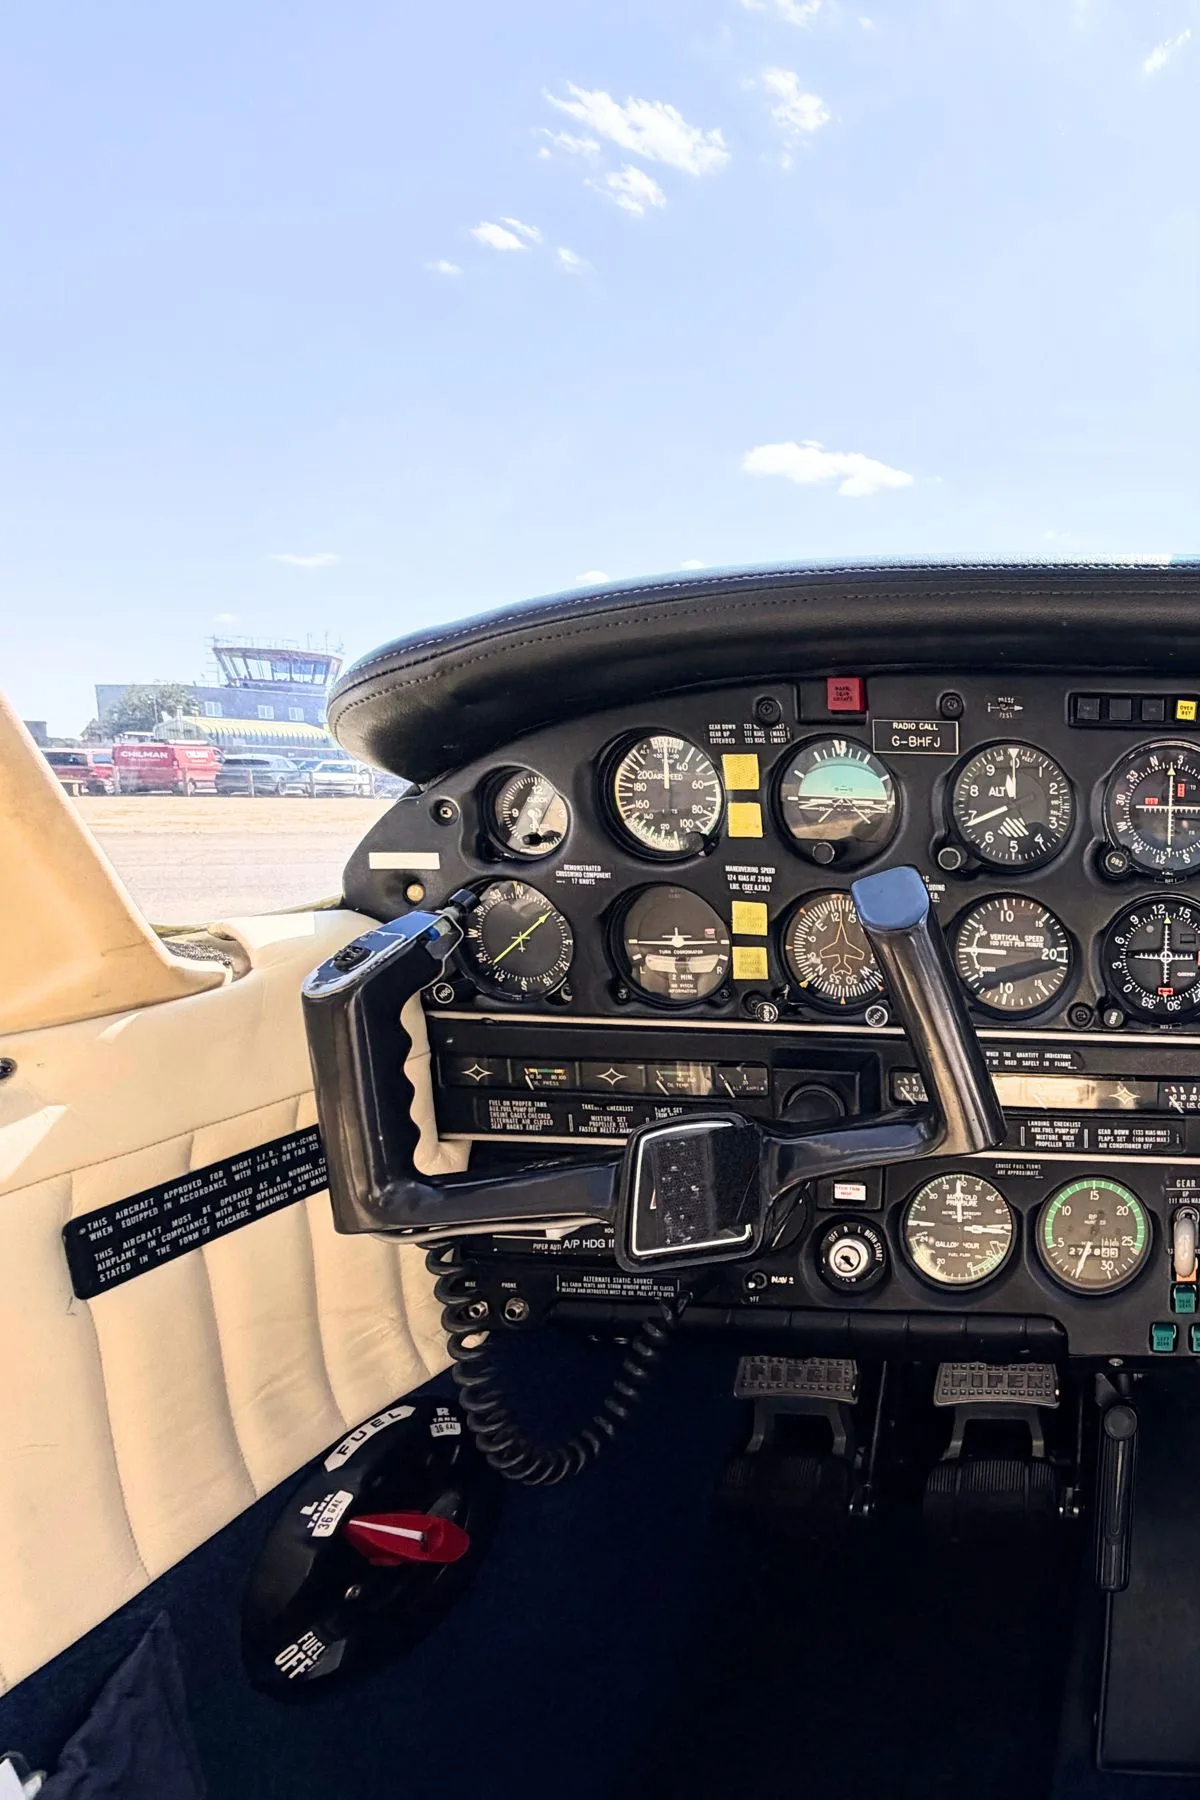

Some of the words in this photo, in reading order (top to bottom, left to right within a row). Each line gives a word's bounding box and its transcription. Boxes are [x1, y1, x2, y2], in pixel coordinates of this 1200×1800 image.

[892, 737, 940, 747] G-BHFJ
[121, 751, 168, 759] CHILMAN
[676, 762, 688, 771] 40
[637, 771, 653, 780] 200
[634, 782, 646, 791] 180
[692, 781, 704, 789] 60
[532, 786, 543, 794] 12
[989, 787, 1005, 796] ALT
[635, 800, 649, 809] 160
[680, 819, 693, 828] 100
[1152, 904, 1165, 915] 12
[1178, 907, 1191, 918] 15
[831, 913, 839, 921] 12
[848, 913, 856, 923] 15
[1001, 911, 1014, 922] 10
[1042, 949, 1057, 960] 20
[87, 1217, 107, 1231] THIS
[115, 1198, 154, 1220] AIRCRAFT
[163, 1179, 202, 1200] APPROVED
[210, 1170, 224, 1180] FOR
[231, 1158, 252, 1173] NIGHT
[282, 1134, 317, 1152] NON-ICING
[1176, 1180, 1196, 1188] GEAR
[89, 1225, 113, 1241] WHEN
[121, 1208, 158, 1229] EQUIPPED
[163, 1202, 173, 1211] IN
[179, 1178, 227, 1205] ACCORDANCE
[234, 1168, 251, 1181] WITH
[257, 1162, 270, 1172] FAR
[282, 1154, 291, 1163] OR
[294, 1147, 306, 1157] FAR
[1090, 1191, 1099, 1199] 15
[94, 1247, 114, 1261] THIS
[122, 1226, 162, 1249] AIRCRAFT
[171, 1213, 192, 1227] MUST
[202, 1205, 212, 1215] BE
[220, 1187, 253, 1206] OPERATED
[259, 1180, 268, 1190] AS
[288, 1163, 313, 1178] NORMAL
[1061, 1206, 1071, 1215] 10
[1117, 1207, 1128, 1215] 20
[97, 1249, 137, 1271] AIRPLANE
[147, 1240, 156, 1248] IN
[161, 1217, 208, 1243] COMPLIANCE
[215, 1205, 233, 1219] WITH
[237, 1198, 250, 1209] THE
[256, 1181, 292, 1200] OPERATING
[99, 1263, 131, 1282] STATED
[139, 1255, 148, 1264] IN
[156, 1244, 171, 1256] THE
[179, 1231, 199, 1246] FORM
[255, 1192, 289, 1211] MARKINGS
[293, 1183, 306, 1195] AND
[563, 1239, 579, 1248] A/P
[583, 1239, 605, 1248] HDG
[1122, 1236, 1133, 1245] 25
[1100, 1260, 1114, 1270] 30
[771, 1276, 785, 1284] NAV
[952, 1373, 1043, 1387] PIPER
[434, 1424, 444, 1433] 36
[446, 1424, 457, 1432] GAL
[338, 1412, 402, 1456] FUEL
[318, 1516, 334, 1530] 36
[327, 1499, 342, 1513] GAL
[298, 1631, 326, 1660] FUEL
[274, 1644, 312, 1679] OFF
